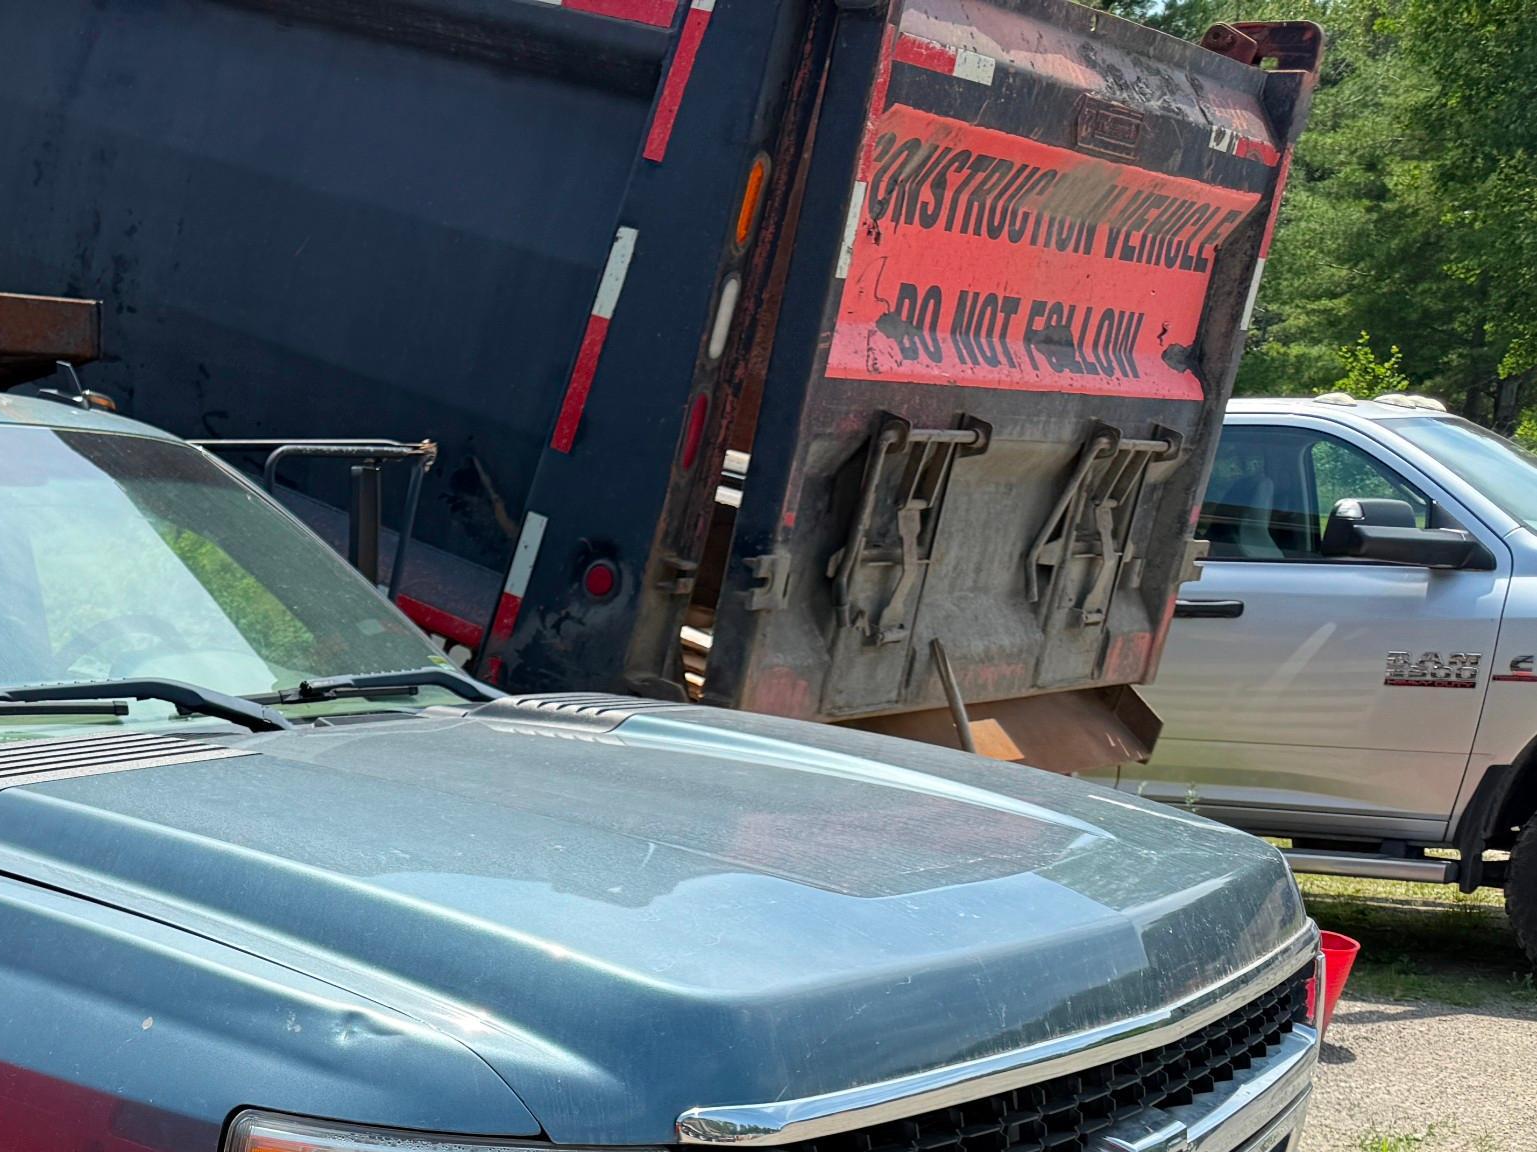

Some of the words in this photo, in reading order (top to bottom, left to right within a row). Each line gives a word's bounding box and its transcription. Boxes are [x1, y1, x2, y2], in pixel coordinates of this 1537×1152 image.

[1104, 188, 1242, 273] VEHICLE
[896, 282, 943, 363] DO
[950, 289, 1019, 370] NOT
[1386, 651, 1482, 665] RAM
